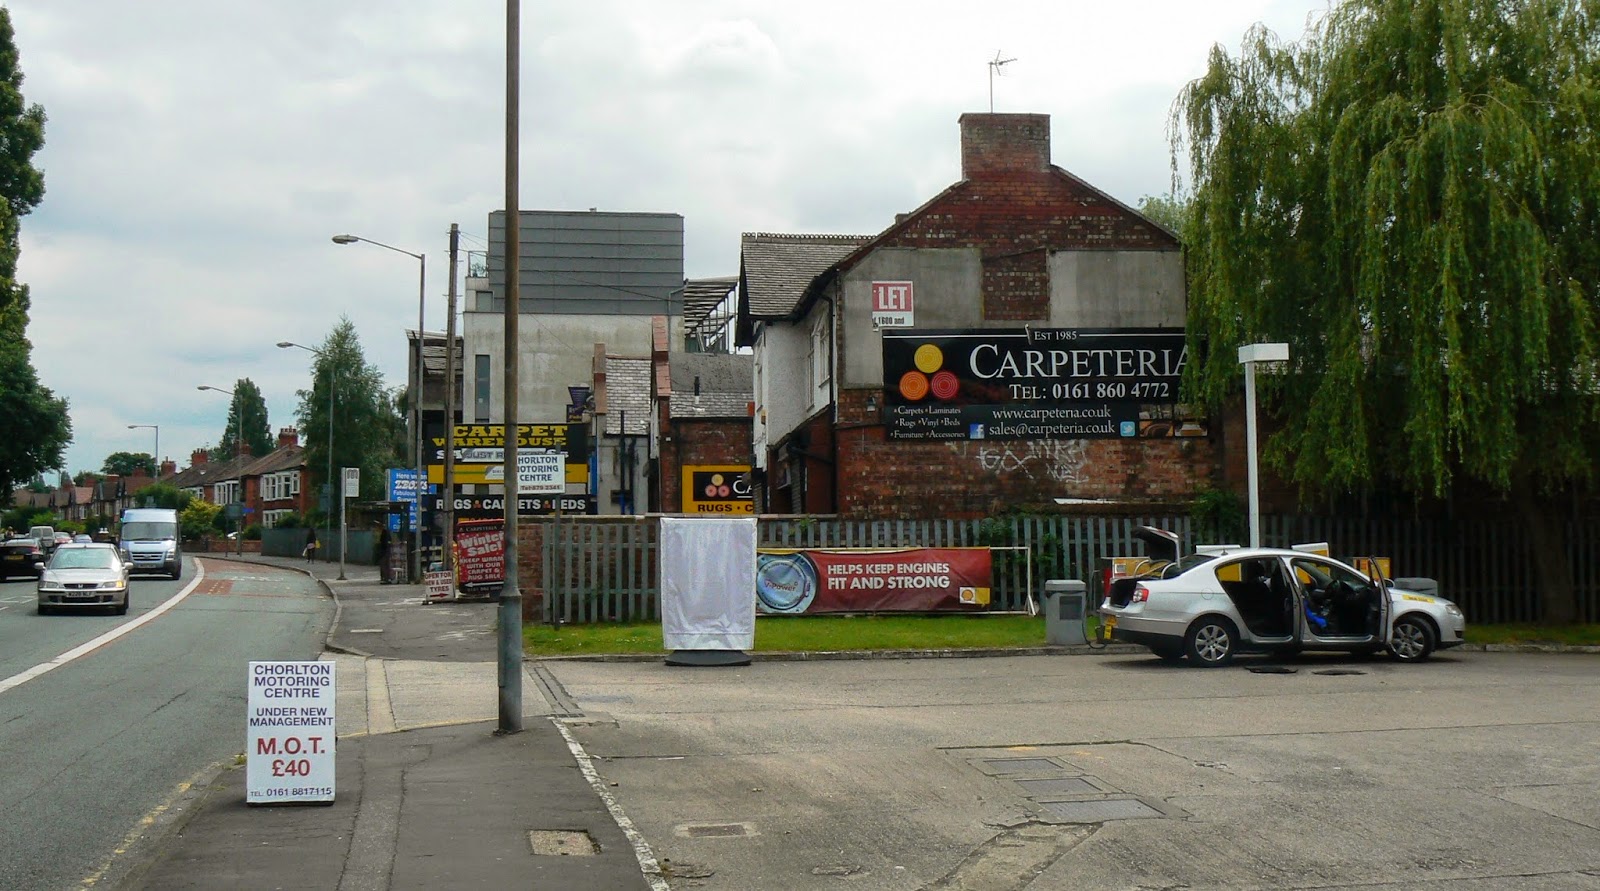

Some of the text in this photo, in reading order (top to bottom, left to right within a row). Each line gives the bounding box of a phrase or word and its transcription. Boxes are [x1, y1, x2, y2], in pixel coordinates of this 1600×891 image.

[878, 286, 908, 310] LET
[1034, 331, 1077, 340] EST 1985
[1052, 383, 1091, 399] 0161
[1096, 383, 1126, 398] 860
[1131, 382, 1170, 398] 4772
[897, 405, 961, 416] Carpets Laminates
[992, 404, 1112, 423] www.carpeteria.co.uk
[899, 417, 960, 428] Rugs Vinyl Beds
[989, 420, 1116, 439] sales@carpeteria.co.uk
[518, 456, 558, 464] HORLTON
[520, 473, 552, 482] CENTRE
[436, 499, 472, 510] RGS
[698, 504, 733, 512] RUGS
[460, 531, 504, 548] Winter
[467, 541, 503, 556] Sale!
[827, 563, 950, 575] HELPS KEEP ENGINES
[827, 575, 951, 590] FIT AND STRONG
[254, 664, 330, 675] CHORLTON
[254, 676, 330, 687] MOTORING
[264, 688, 321, 698] CENTRE
[256, 707, 327, 717] UNDER NEW
[250, 717, 334, 727] MANAGEMENT
[257, 737, 326, 755] M.O.T.
[272, 759, 311, 777] £40
[266, 788, 289, 797] 0161
[292, 787, 332, 796] 8817115
